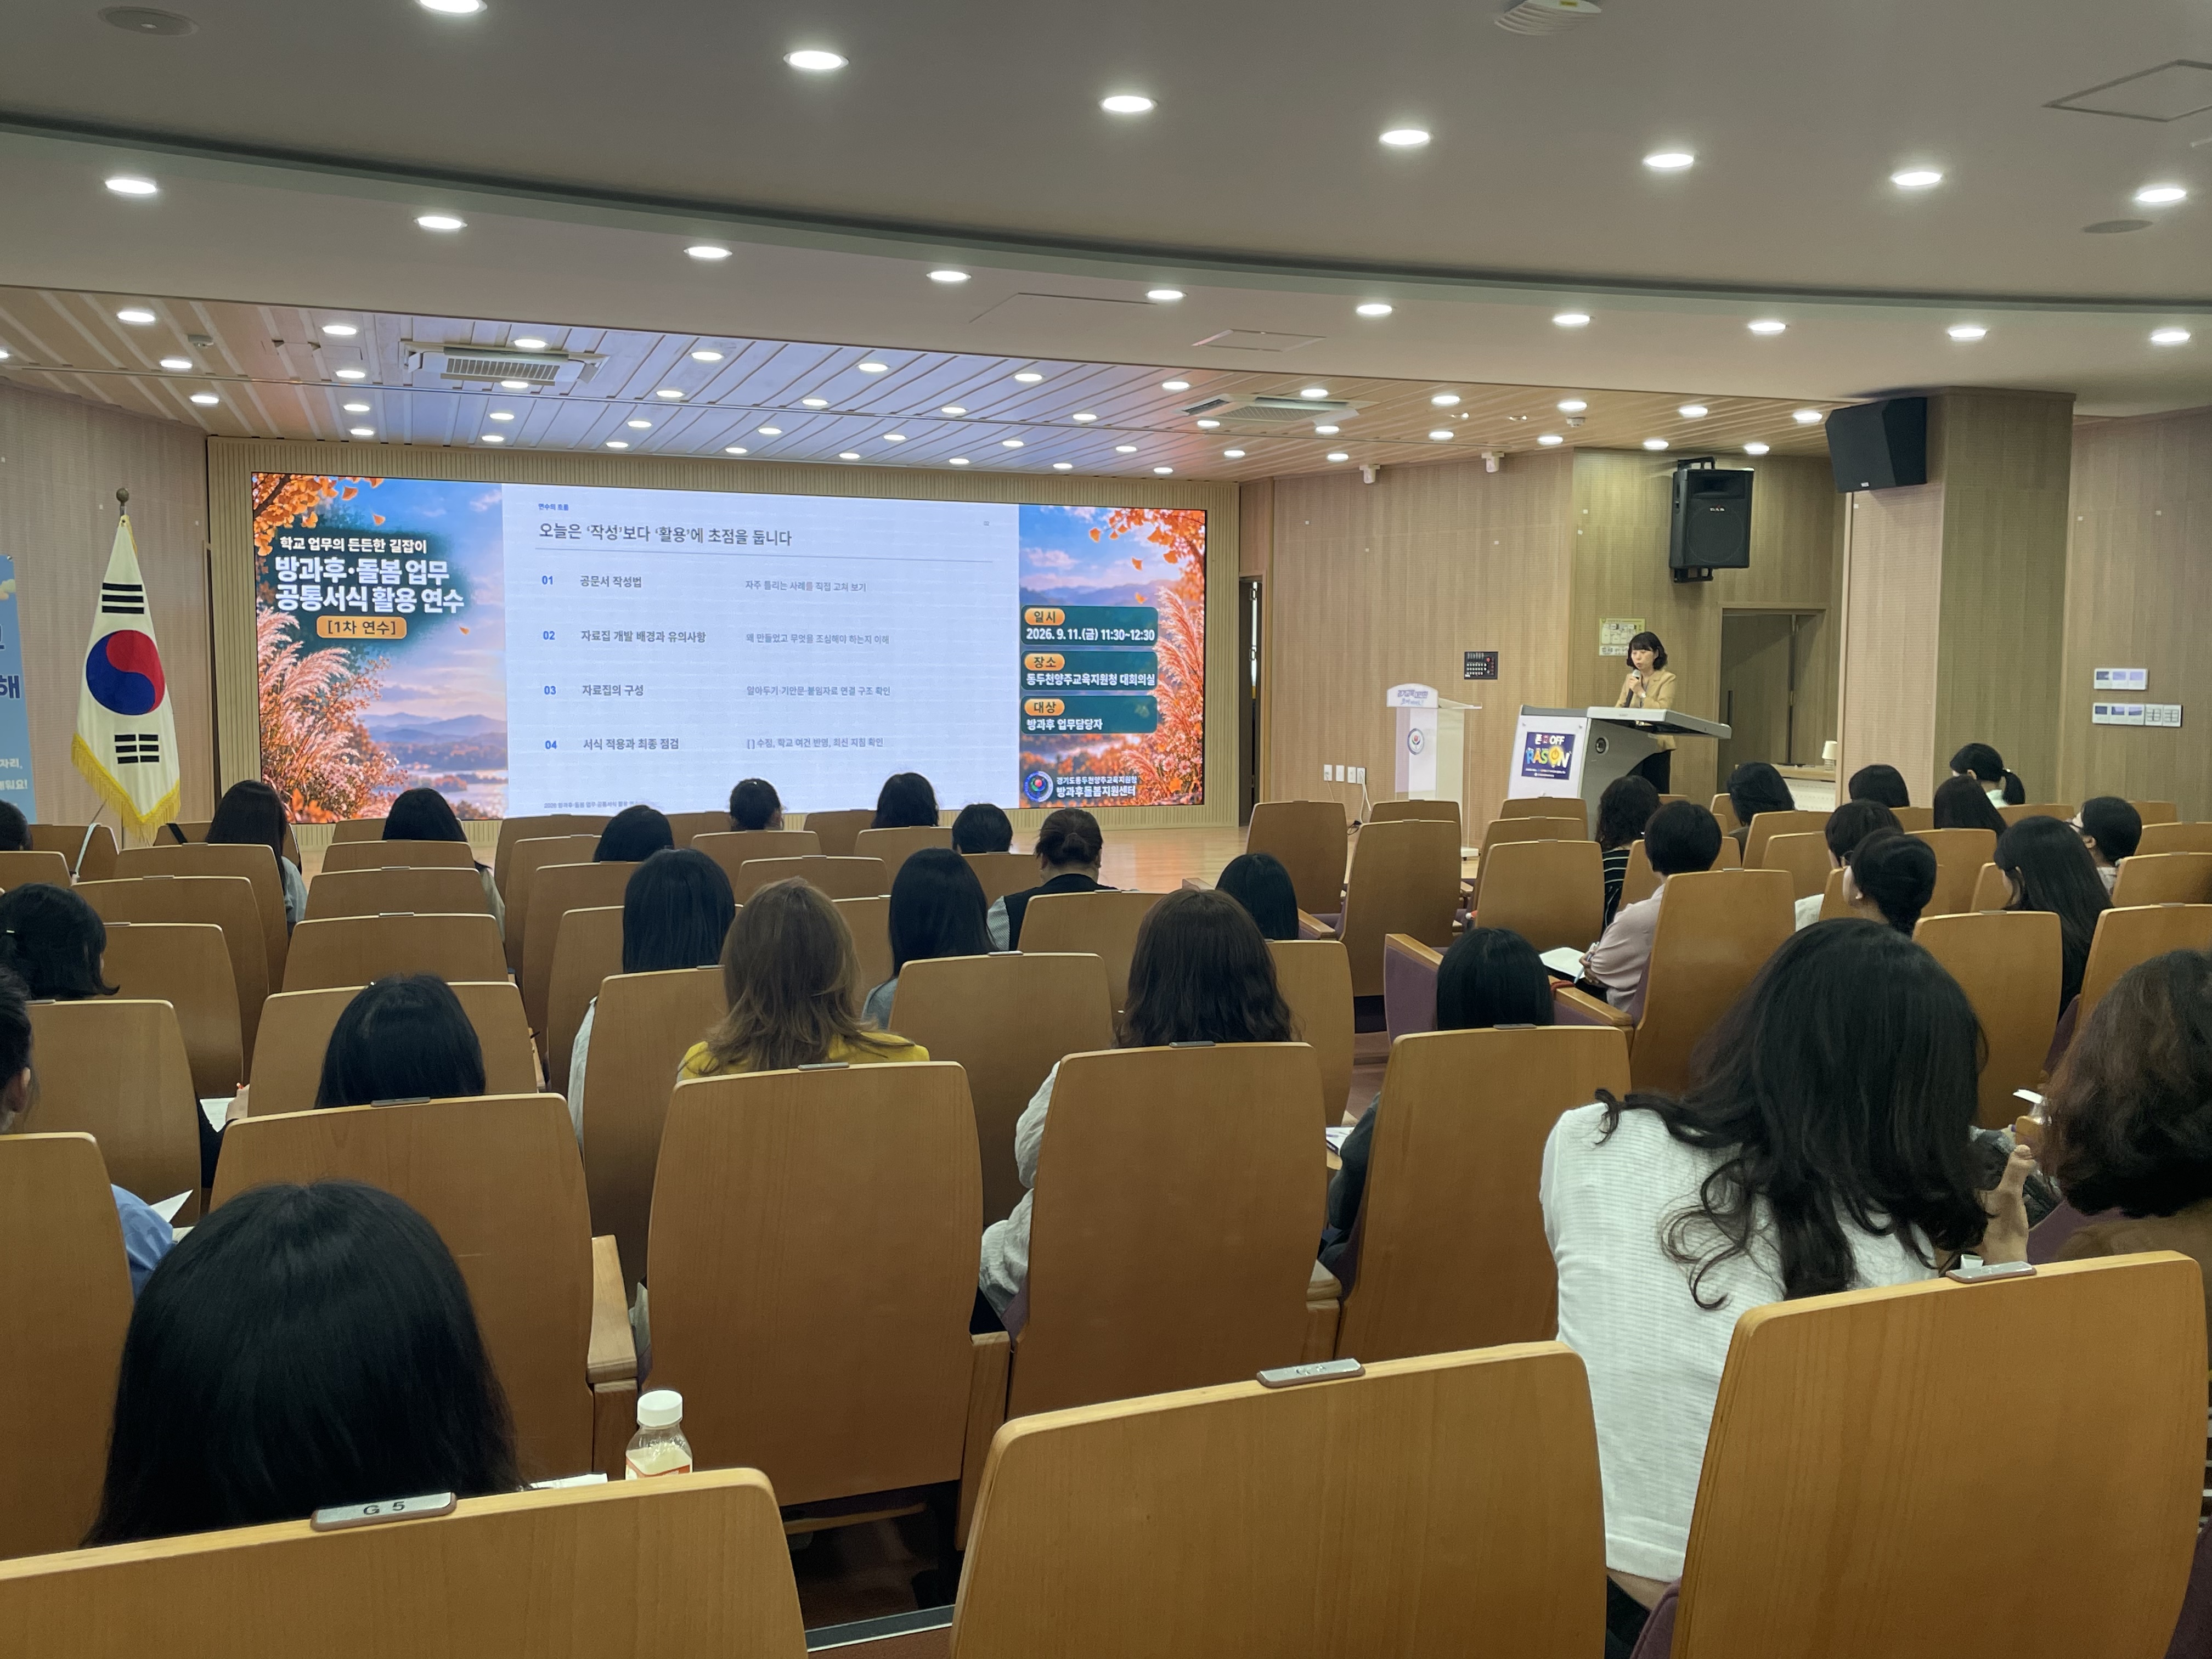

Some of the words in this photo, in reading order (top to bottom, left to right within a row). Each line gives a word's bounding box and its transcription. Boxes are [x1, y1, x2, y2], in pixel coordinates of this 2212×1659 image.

[538, 503, 556, 511] 연수의
[539, 523, 582, 540] 오늘은
[708, 528, 748, 545] 초점을
[752, 529, 792, 546] 둡니다
[280, 537, 306, 551] 학교
[308, 537, 345, 552] 업무의
[348, 538, 386, 553] 든든한
[390, 539, 427, 554] 길잡이
[405, 560, 450, 586] 업무
[541, 575, 554, 585] 01
[580, 575, 610, 588] 공문서
[613, 576, 642, 588] 작성법
[745, 580, 761, 590] 자주
[764, 580, 787, 591] 틀리는
[789, 581, 813, 591] 사례를
[816, 582, 831, 592] 직접
[833, 582, 849, 592] 고쳐
[851, 583, 866, 592] 보기
[275, 584, 368, 612] 공통서식
[372, 586, 417, 613] 활용
[421, 588, 464, 613] 연수
[328, 620, 357, 635] [1차
[363, 620, 396, 635] 연수]
[543, 630, 555, 640] 02
[581, 630, 611, 642] 자료집
[614, 630, 633, 642] 개발
[636, 631, 665, 642] 배경과
[668, 631, 706, 643] 유의사항
[746, 633, 754, 643] 왜
[757, 633, 788, 644] 만들었고
[791, 634, 814, 644] 무엇을
[849, 635, 872, 645] 하는지
[874, 635, 889, 645] 이해
[1026, 628, 1055, 640] 2026.
[1057, 629, 1066, 640] 9.
[1101, 629, 1155, 641] 11:30~12:30
[1026, 673, 1118, 686] 동두천양주교육지원청
[1120, 674, 1155, 686] 대회의실
[544, 685, 556, 695] 03
[582, 685, 622, 696] 자료집의
[624, 685, 644, 696] 구성
[840, 686, 856, 696] 연결
[857, 686, 873, 696] 구조
[875, 686, 890, 696] 확인
[1026, 719, 1055, 731] 방과후
[1057, 719, 1103, 731] 업무담당자
[545, 740, 557, 750] 04
[583, 739, 603, 750] 서식
[606, 738, 635, 750] 적용과
[638, 738, 657, 749] 최종
[660, 738, 679, 749] 점검
[777, 738, 793, 748] 학교
[795, 737, 811, 748] 여건
[833, 737, 849, 747] 최신
[851, 737, 866, 747] 지침
[868, 737, 883, 747] 확인
[1549, 735, 1565, 745] OFF
[1057, 785, 1136, 798] 방과후돌봄지원센터
[363, 1505, 380, 1515] G
[392, 1501, 405, 1511] 5
